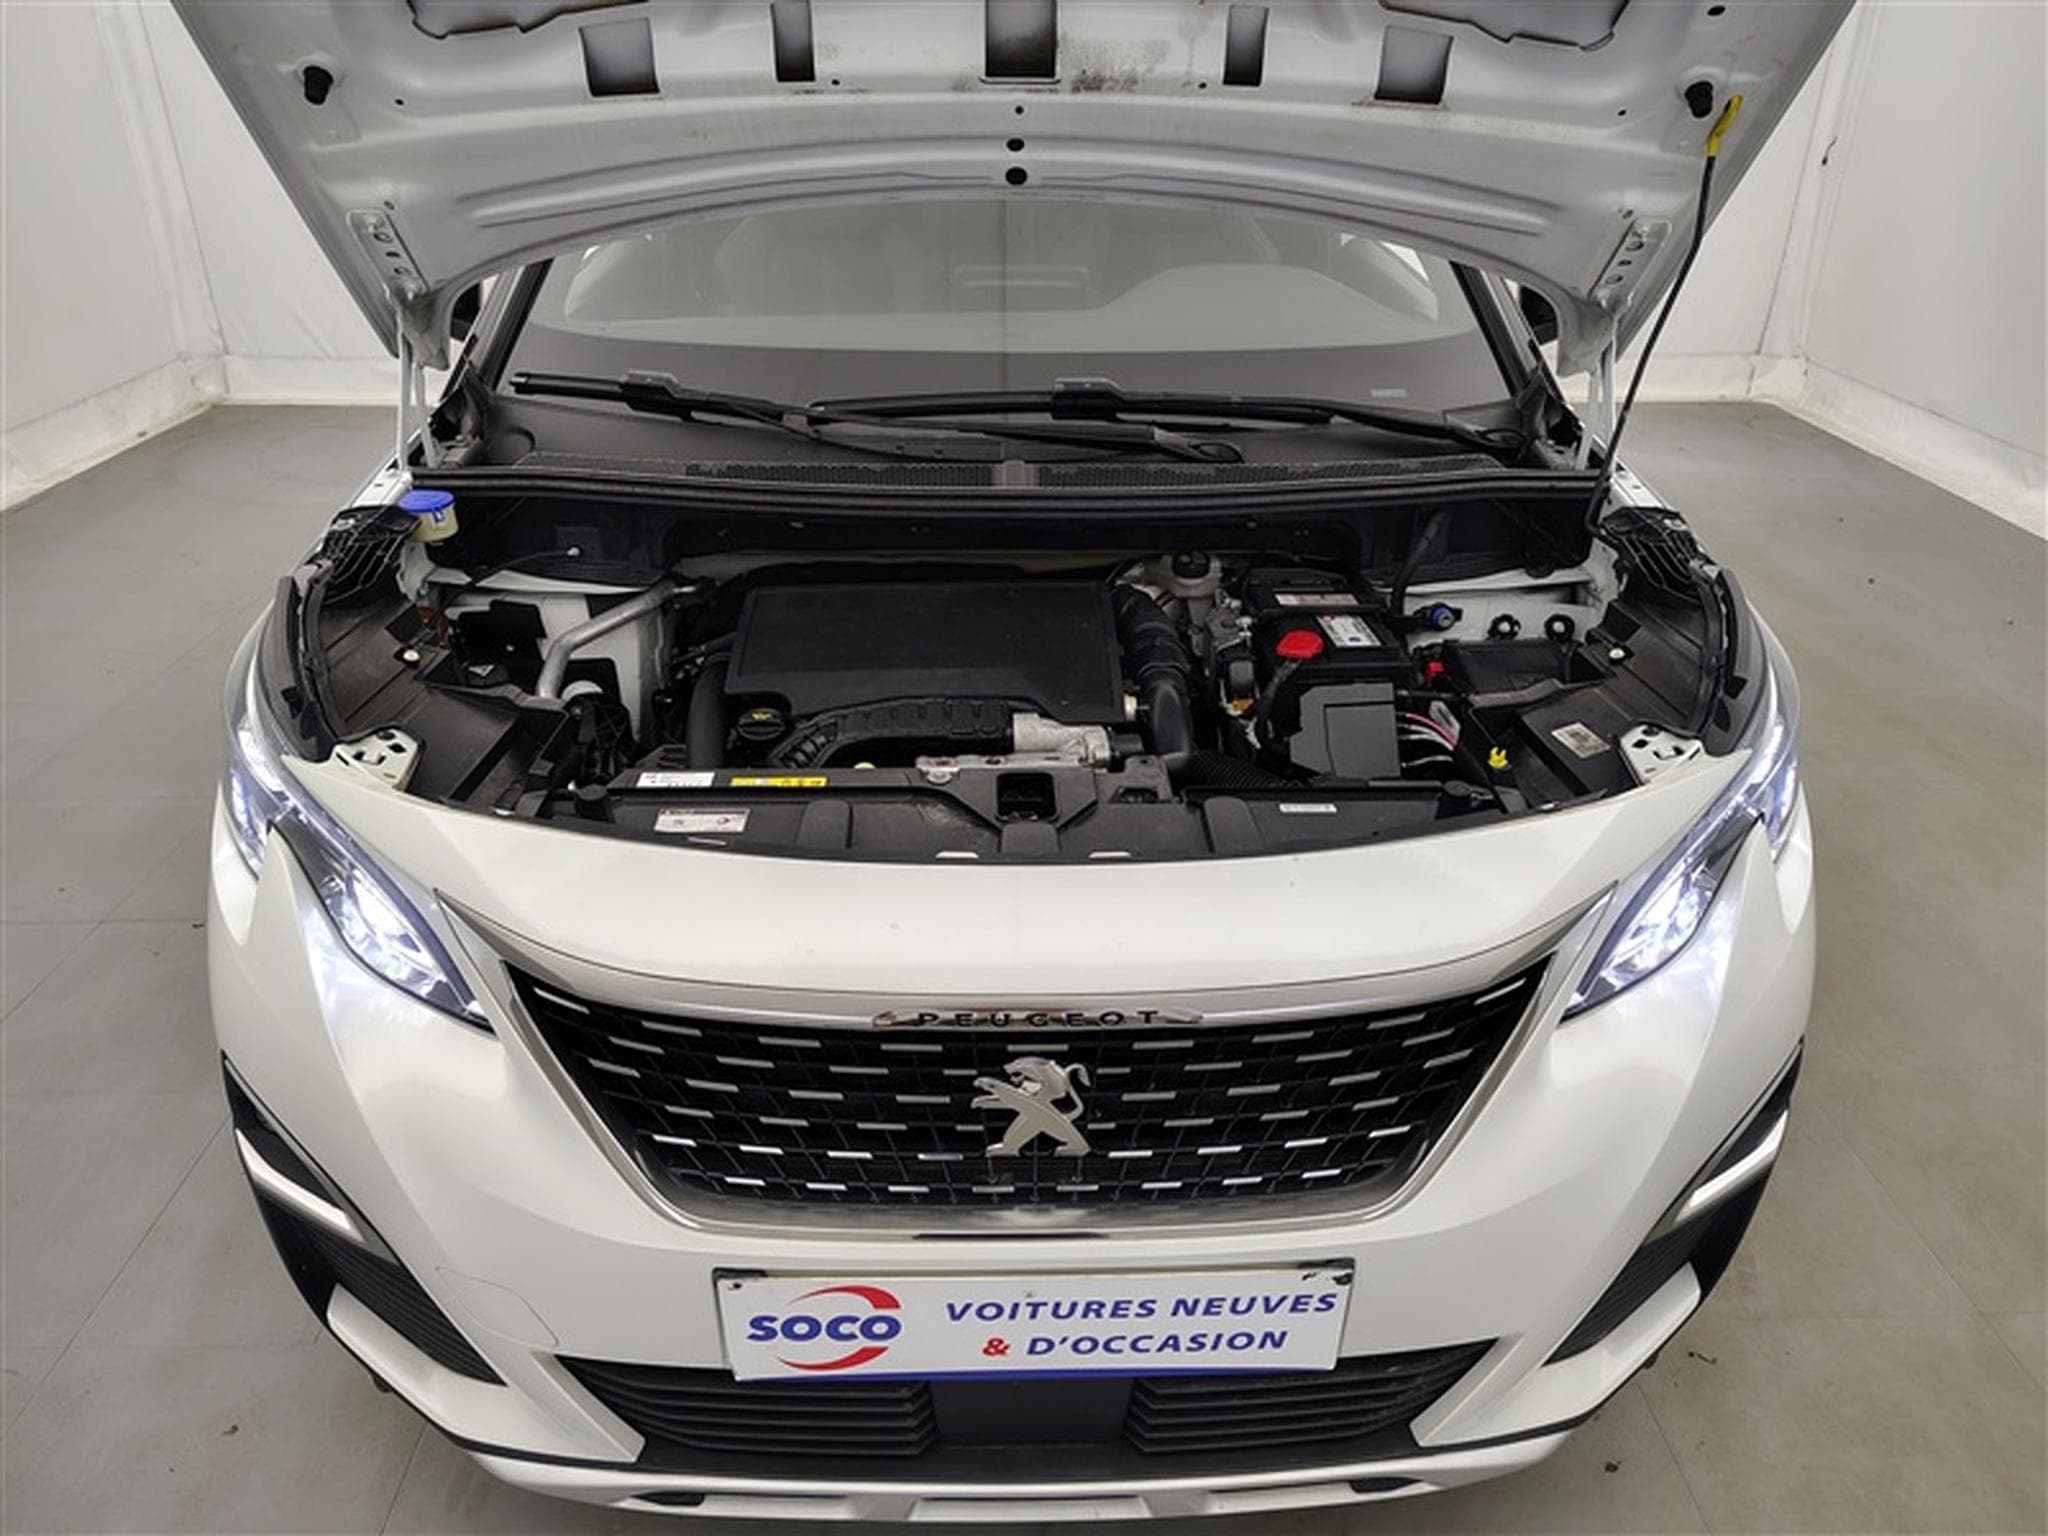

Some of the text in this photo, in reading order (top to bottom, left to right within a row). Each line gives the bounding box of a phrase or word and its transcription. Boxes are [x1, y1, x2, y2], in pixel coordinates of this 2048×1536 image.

[917, 1009, 1160, 1028] PEUGEOT
[946, 1293, 1338, 1322] VOITURES NEUVES
[747, 1313, 903, 1343] SOCO
[982, 1330, 1289, 1357] & D'OCCASION
